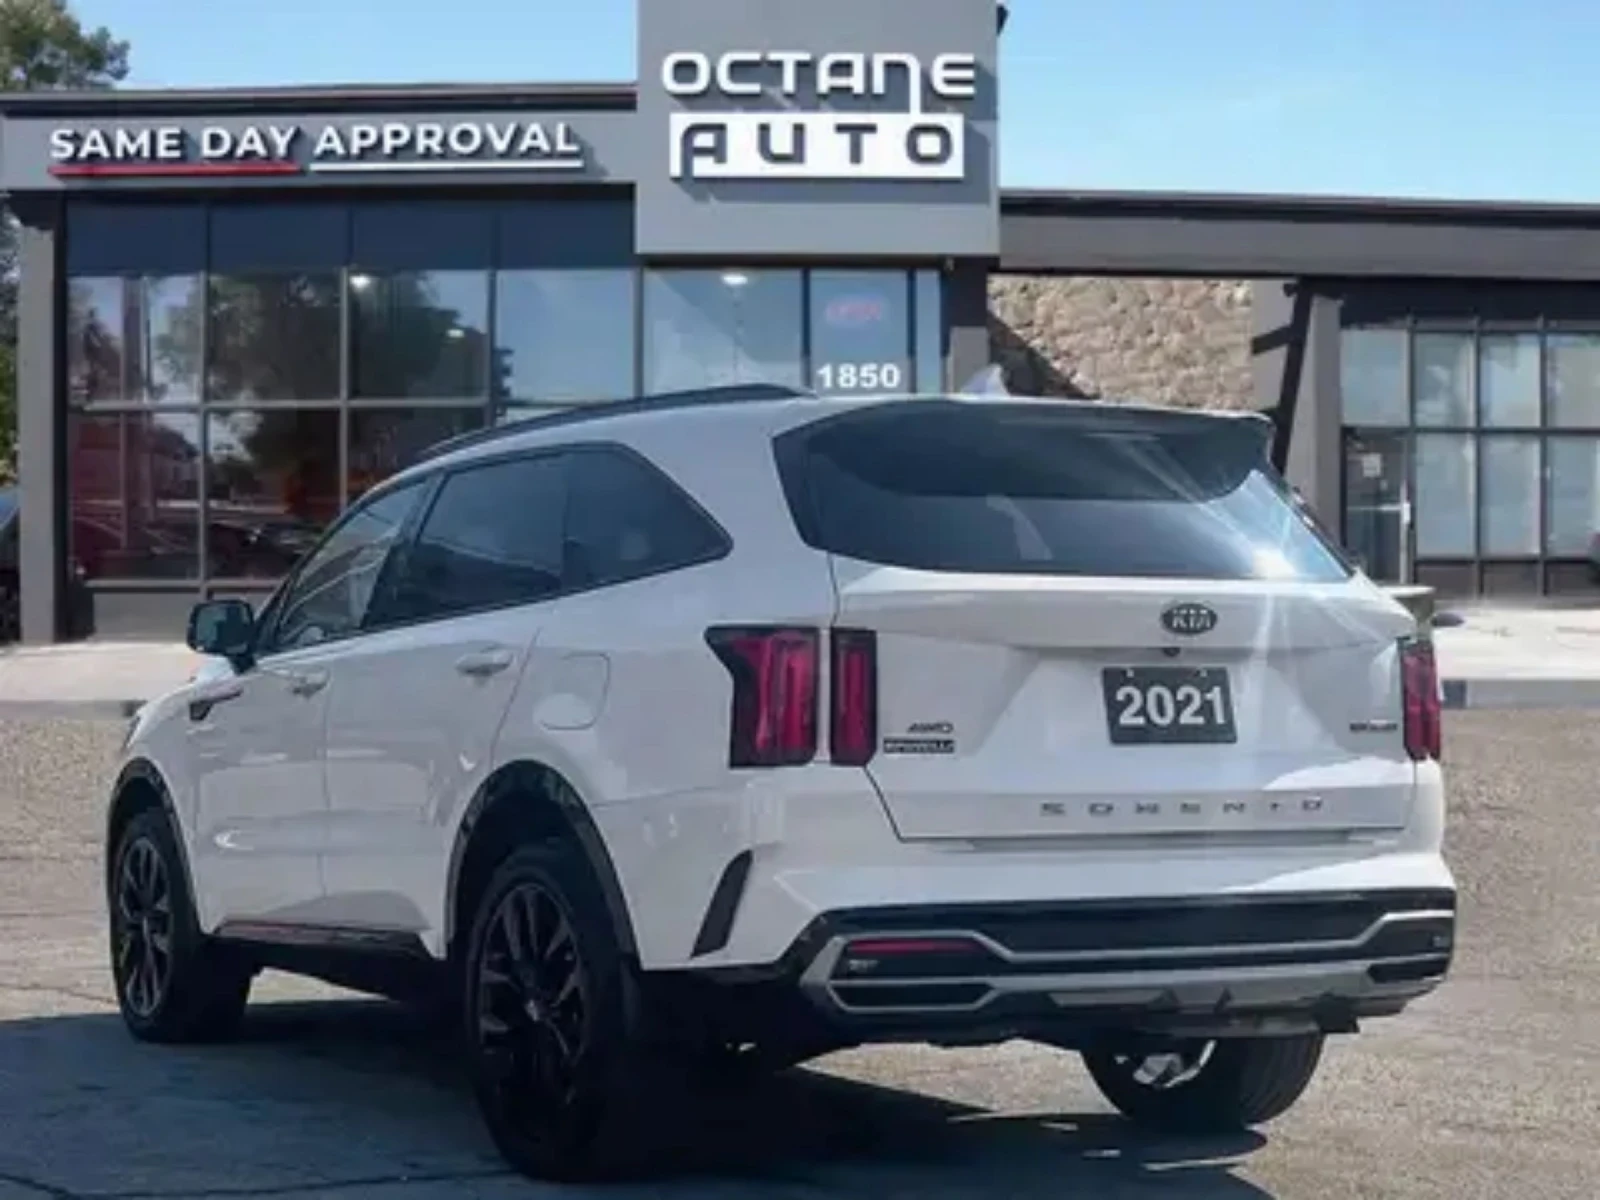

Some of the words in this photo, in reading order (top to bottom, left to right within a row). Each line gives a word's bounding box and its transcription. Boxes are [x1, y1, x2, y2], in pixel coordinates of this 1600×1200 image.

[662, 52, 976, 113] OCTANE
[50, 127, 182, 159] SAME
[202, 125, 296, 158] DAY
[313, 121, 581, 156] APPROVAL
[680, 122, 954, 177] AUTO
[816, 363, 901, 389] 1850
[1172, 608, 1211, 629] KIA
[1116, 685, 1225, 726] 2021
